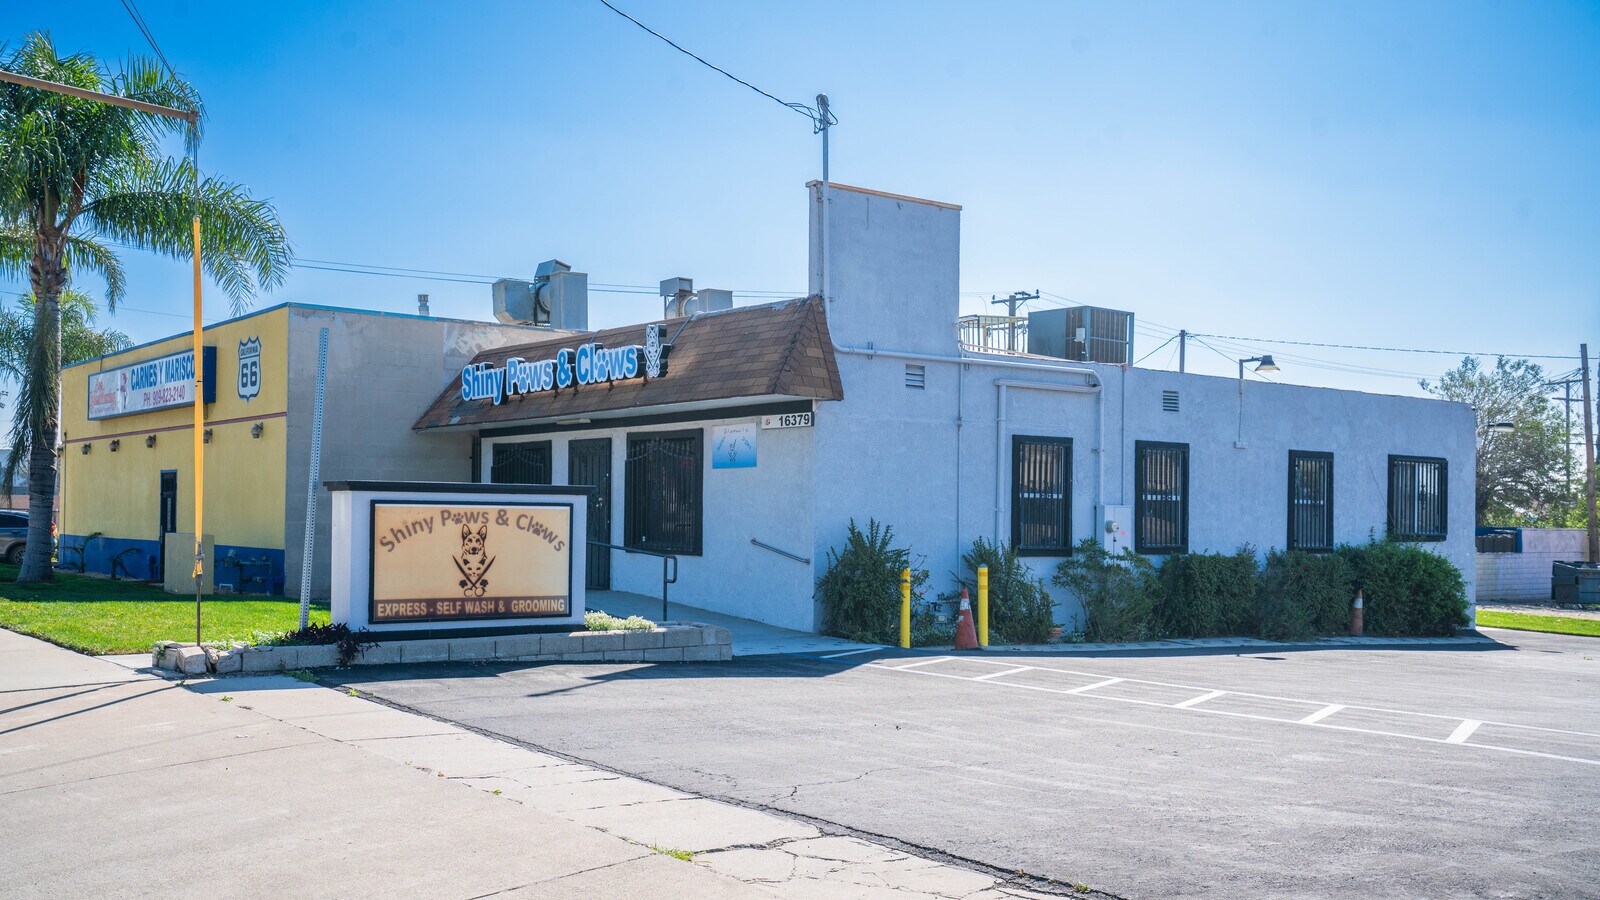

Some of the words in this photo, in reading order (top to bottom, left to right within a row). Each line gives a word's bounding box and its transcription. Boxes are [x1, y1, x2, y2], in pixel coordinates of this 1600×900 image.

[240, 345, 259, 357] CALIFORNIA
[131, 363, 158, 391] CARNES
[158, 361, 164, 385] Y
[241, 360, 258, 388] 66
[461, 363, 504, 406] Shiny
[556, 347, 573, 389] &
[778, 413, 810, 427] 16379
[379, 515, 434, 553] Shiny
[495, 509, 509, 526] &
[377, 602, 427, 617] EXPRESS
[436, 601, 462, 615] SELF
[465, 600, 494, 615] WASH
[498, 600, 505, 613] &
[511, 598, 565, 612] GROOMING
